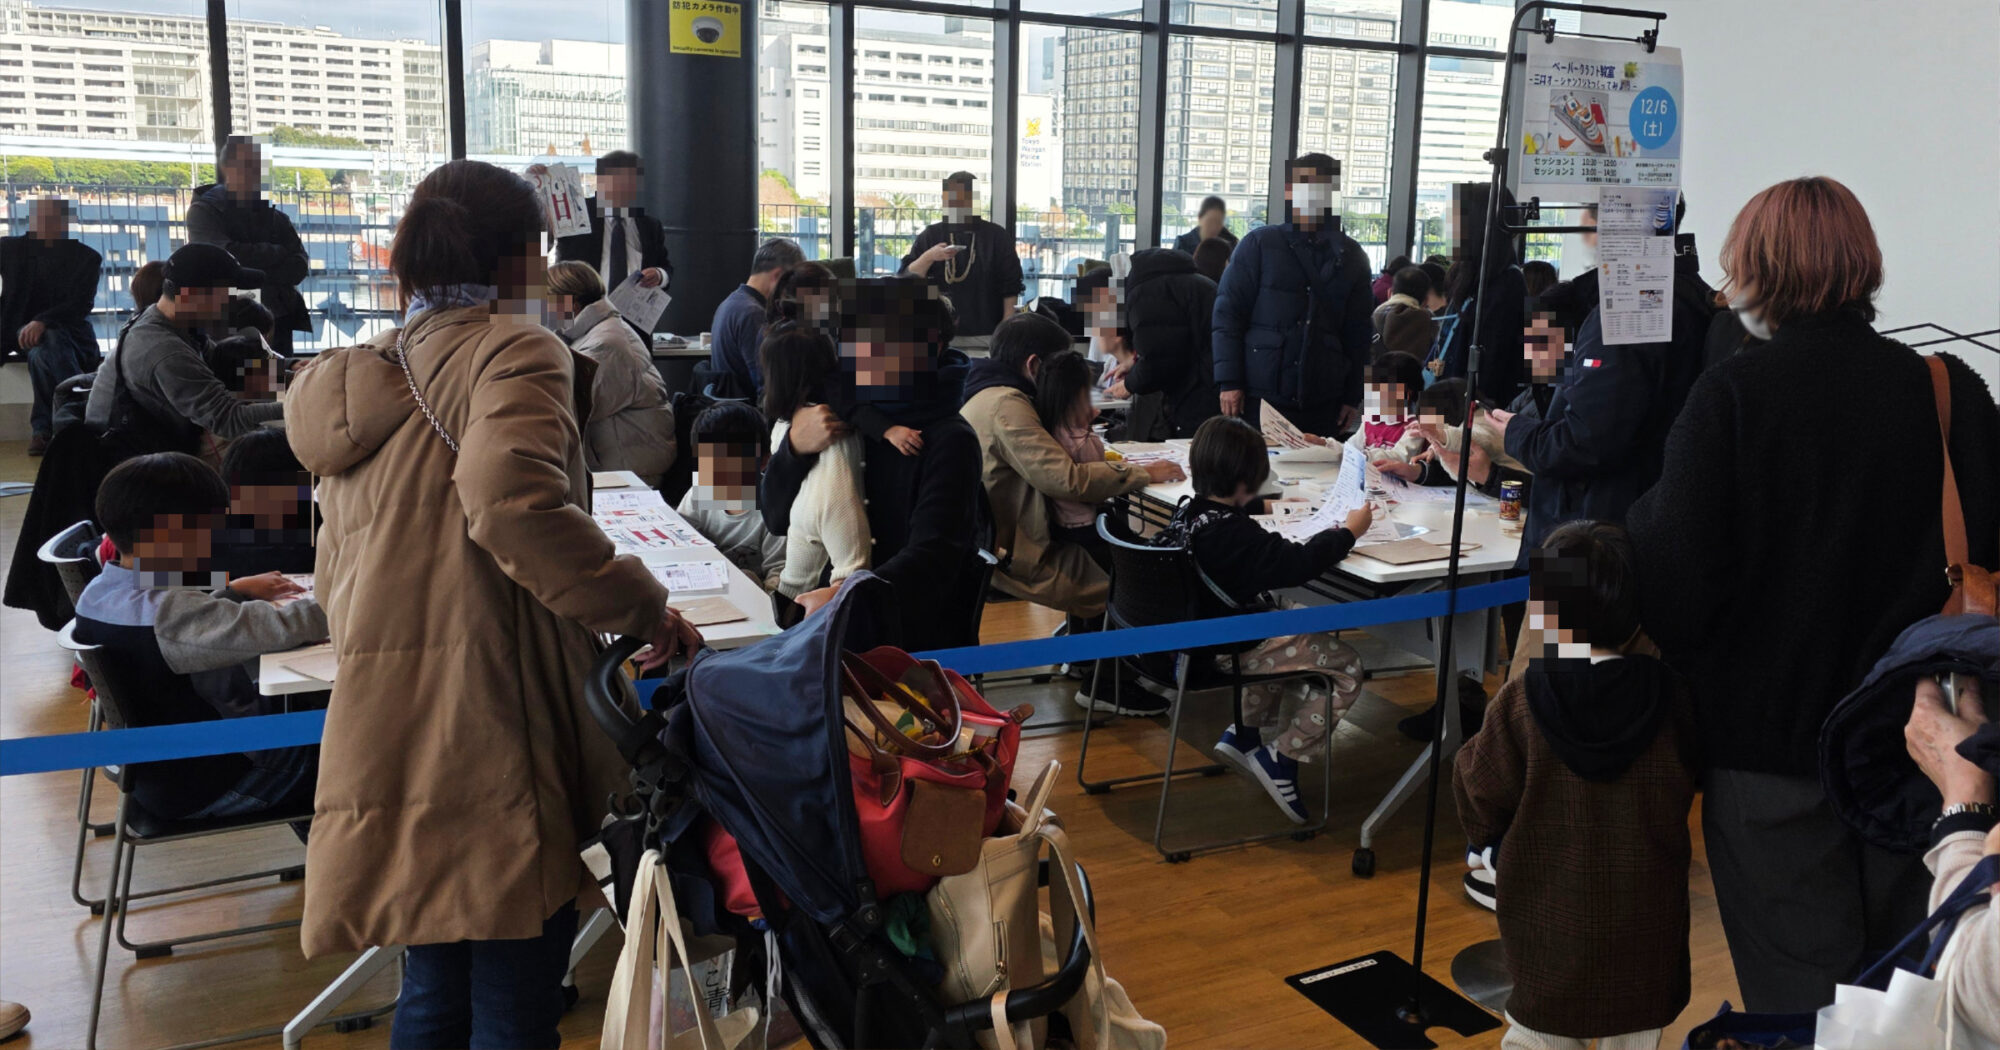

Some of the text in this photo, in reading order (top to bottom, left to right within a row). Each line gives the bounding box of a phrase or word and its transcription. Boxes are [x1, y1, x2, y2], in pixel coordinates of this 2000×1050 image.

[672, 1, 739, 14] 防犯カメラ作動中
[1641, 98, 1669, 115] 12/6
